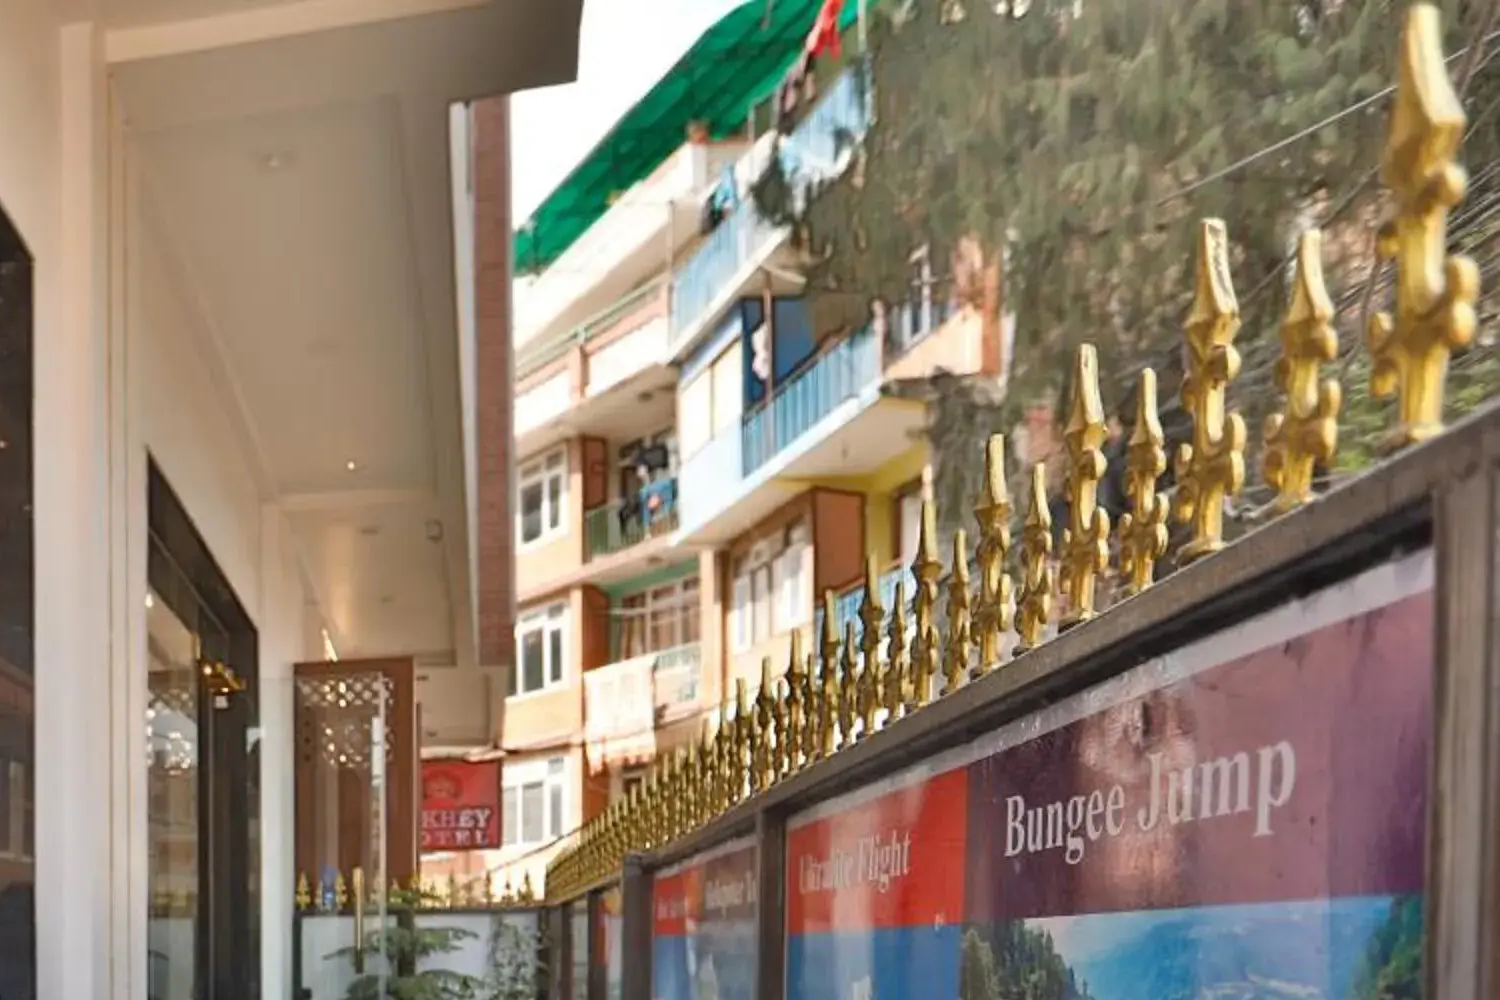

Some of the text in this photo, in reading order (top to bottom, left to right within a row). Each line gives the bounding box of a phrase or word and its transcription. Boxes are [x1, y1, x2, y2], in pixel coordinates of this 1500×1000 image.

[1004, 739, 1296, 864] Bungee Jump
[857, 829, 912, 894] Flight
